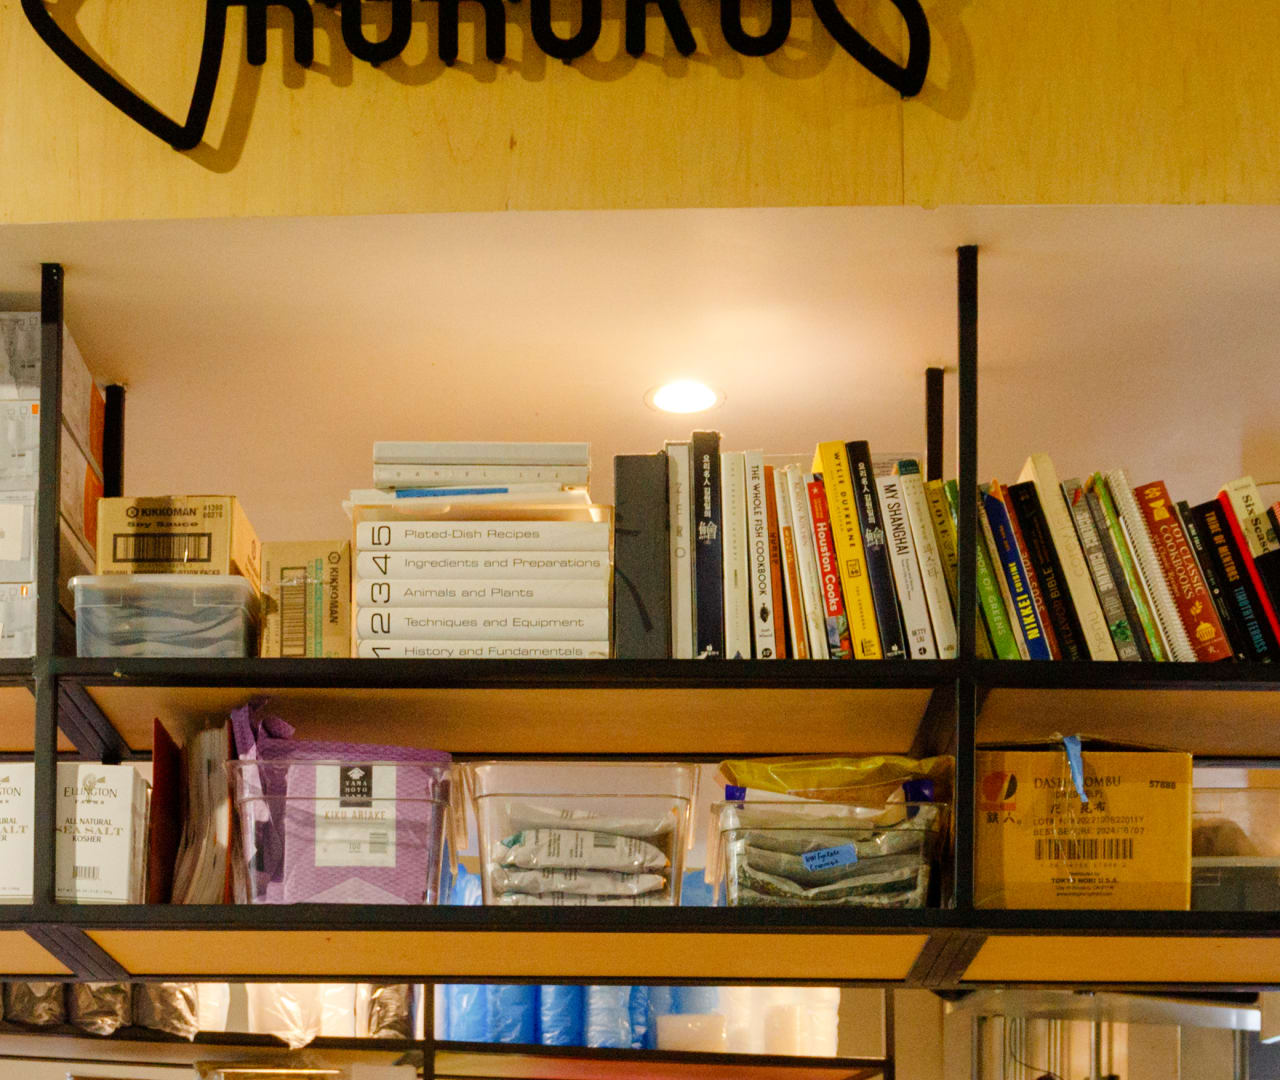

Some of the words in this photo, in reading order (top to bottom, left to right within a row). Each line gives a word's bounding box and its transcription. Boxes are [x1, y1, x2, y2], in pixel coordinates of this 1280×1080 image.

[751, 465, 761, 481] THE
[752, 483, 762, 516] WHOLE
[833, 451, 846, 485] WYLIE
[841, 491, 856, 549] DUFRESNE
[883, 483, 898, 500] MY
[141, 506, 197, 517] KIKKOMAN
[1241, 493, 1256, 516] Six
[127, 521, 153, 529] Soy
[753, 519, 764, 538] FISH
[886, 501, 910, 556] SHANGHAI
[932, 499, 951, 540] LOVE
[1204, 510, 1219, 531] TRIBE
[371, 525, 392, 546] 5
[404, 529, 483, 540] Plated-Dish
[487, 529, 541, 541] Recipes
[1214, 528, 1226, 545] OF
[816, 522, 832, 573] Houston
[371, 554, 392, 576] 4
[404, 558, 480, 569] Ingredients
[483, 558, 507, 567] and
[513, 558, 601, 570] Preparations
[755, 541, 767, 596] COOKBOOK
[1089, 552, 1114, 593] COOKING
[1158, 523, 1195, 600] COOKBOOKS
[1179, 544, 1204, 596] CLASSIC
[1218, 542, 1240, 583] MENTORS
[1008, 562, 1024, 594] CUISINE
[1042, 567, 1061, 599] BIBLE
[328, 566, 340, 625] KIKKOMAN
[370, 582, 391, 604] 3
[403, 588, 457, 598] Animals
[461, 588, 486, 597] and
[491, 588, 535, 598] Plants
[823, 575, 838, 612] Cooks
[370, 612, 391, 634] 2
[404, 617, 478, 629] Techniques
[482, 617, 508, 627] and
[513, 617, 585, 629] Equipment
[987, 594, 1007, 636] GREENS
[1016, 593, 1041, 640] NIKKEI
[404, 646, 454, 657] History
[458, 646, 483, 656] and
[489, 646, 583, 656] Fundamentals
[1085, 775, 1121, 788] OMBU
[63, 787, 118, 799] ELLINGTON
[55, 826, 81, 835] SEA
[84, 827, 124, 836] SALT
[79, 818, 112, 826] NATURAL
[72, 835, 102, 843] KOSHER
